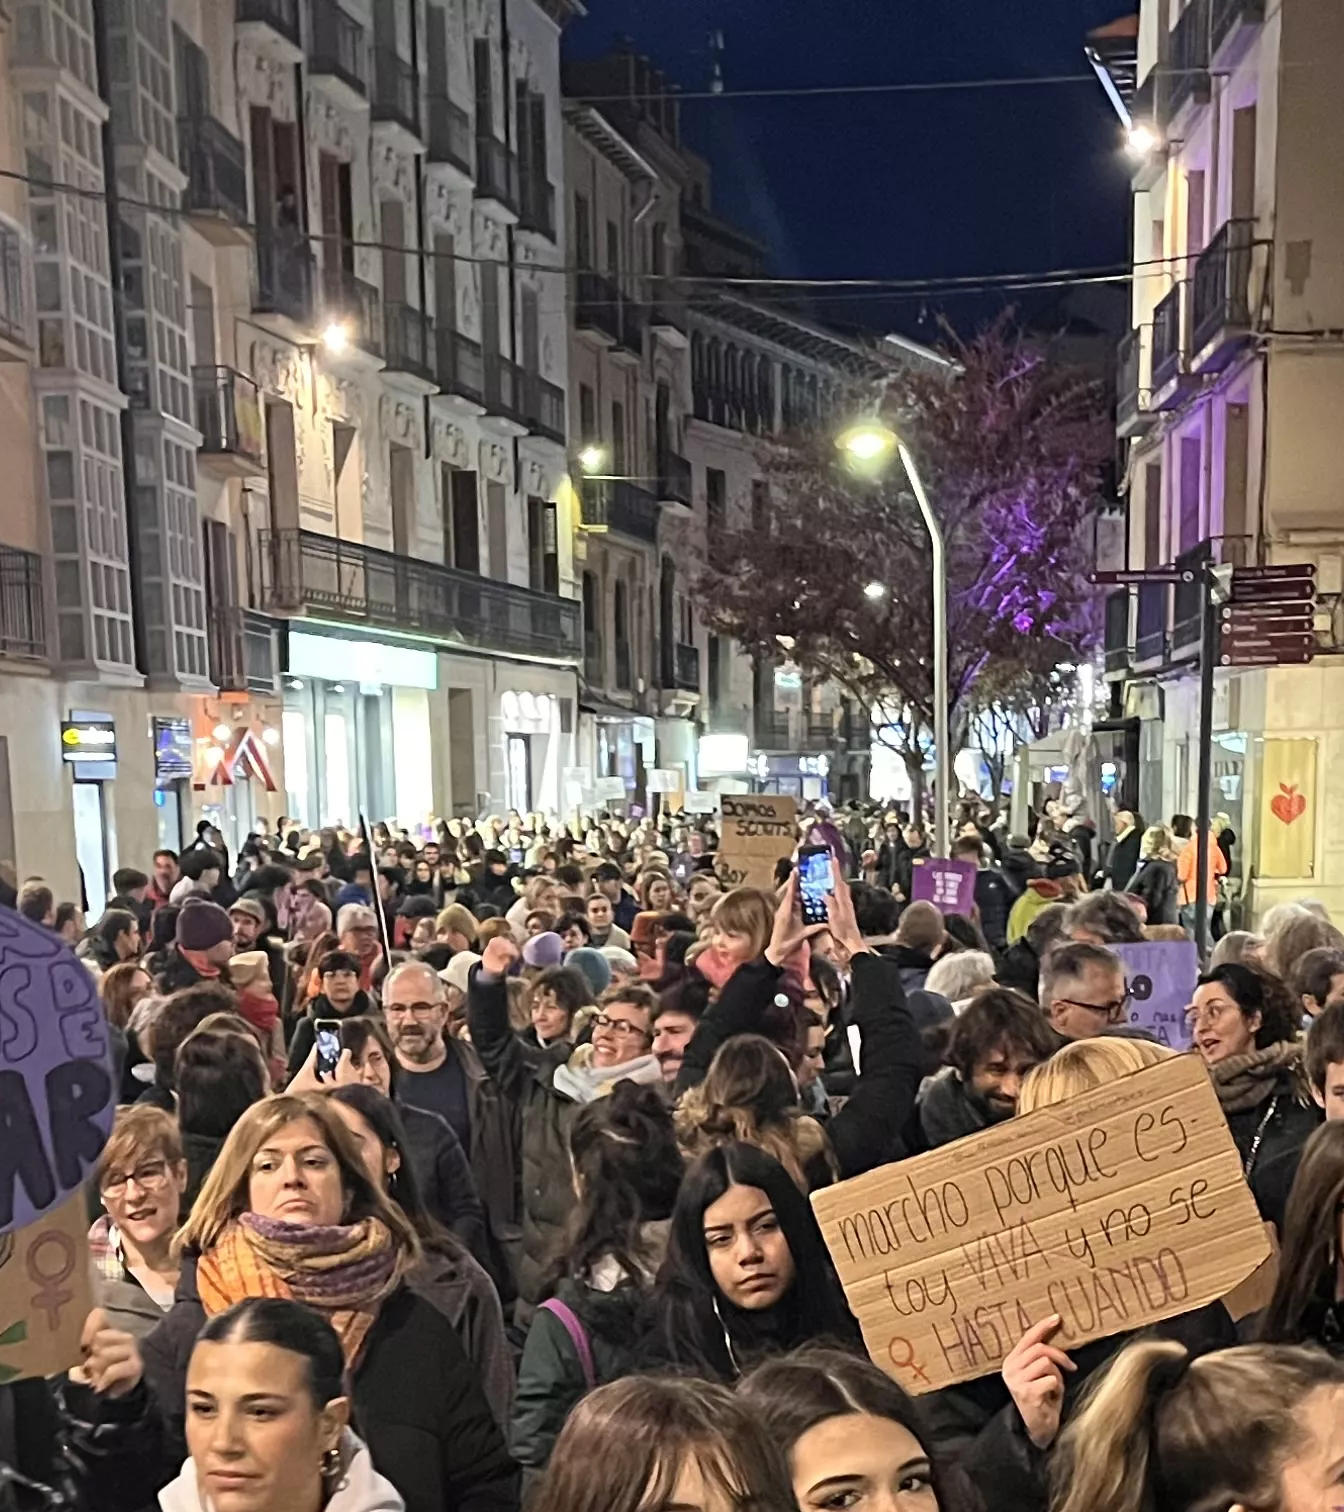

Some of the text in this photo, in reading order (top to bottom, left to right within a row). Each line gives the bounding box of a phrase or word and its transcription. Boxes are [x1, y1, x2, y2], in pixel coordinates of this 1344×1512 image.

[49, 960, 106, 1058] DE
[838, 1175, 971, 1264] marcho
[984, 1126, 1118, 1226] porque
[883, 1269, 958, 1317] toy
[960, 1217, 1052, 1291] VIVA
[1065, 1228, 1096, 1270] y
[1100, 1202, 1152, 1248] no
[932, 1246, 1189, 1373] HASTA CUANDO
